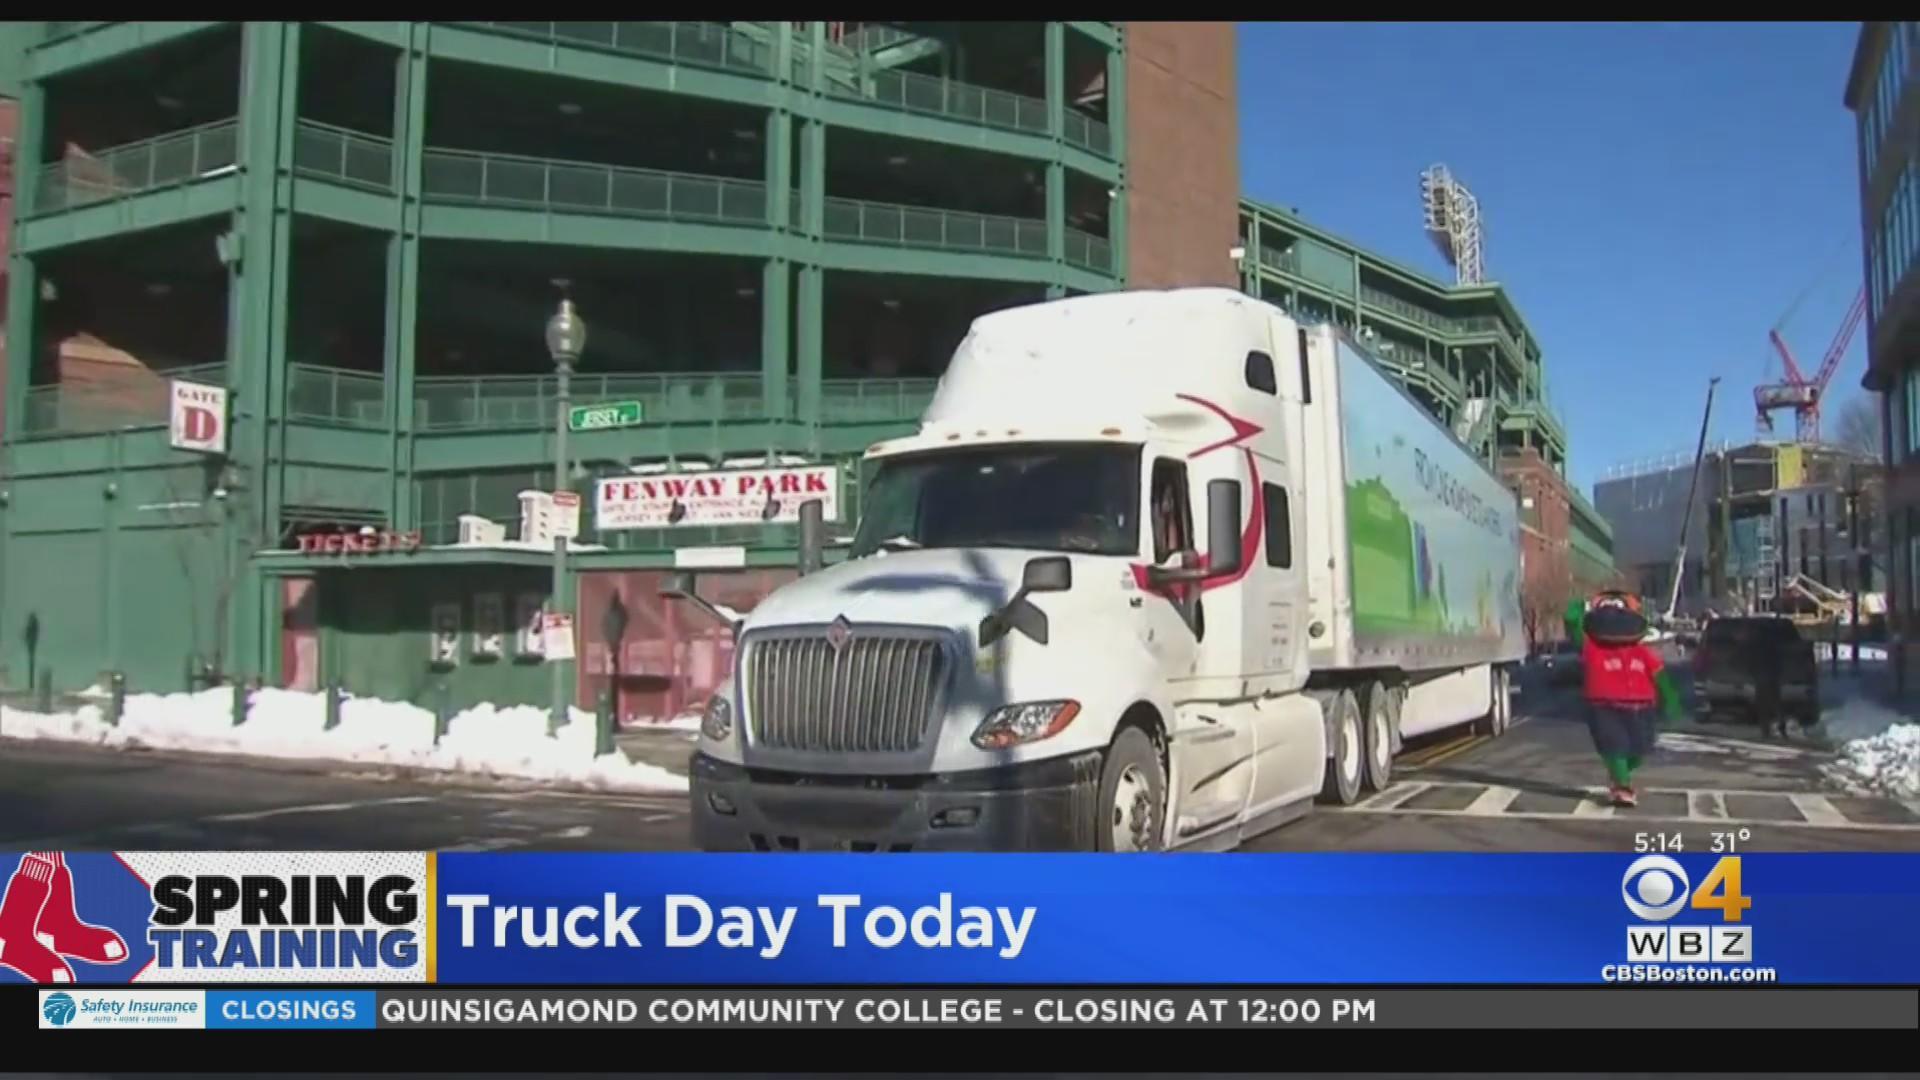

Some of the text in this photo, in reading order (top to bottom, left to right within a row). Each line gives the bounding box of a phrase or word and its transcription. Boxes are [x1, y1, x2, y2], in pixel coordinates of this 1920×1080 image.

[177, 388, 221, 404] GATE
[183, 406, 217, 442] D
[604, 472, 828, 501] FENWAY PARK
